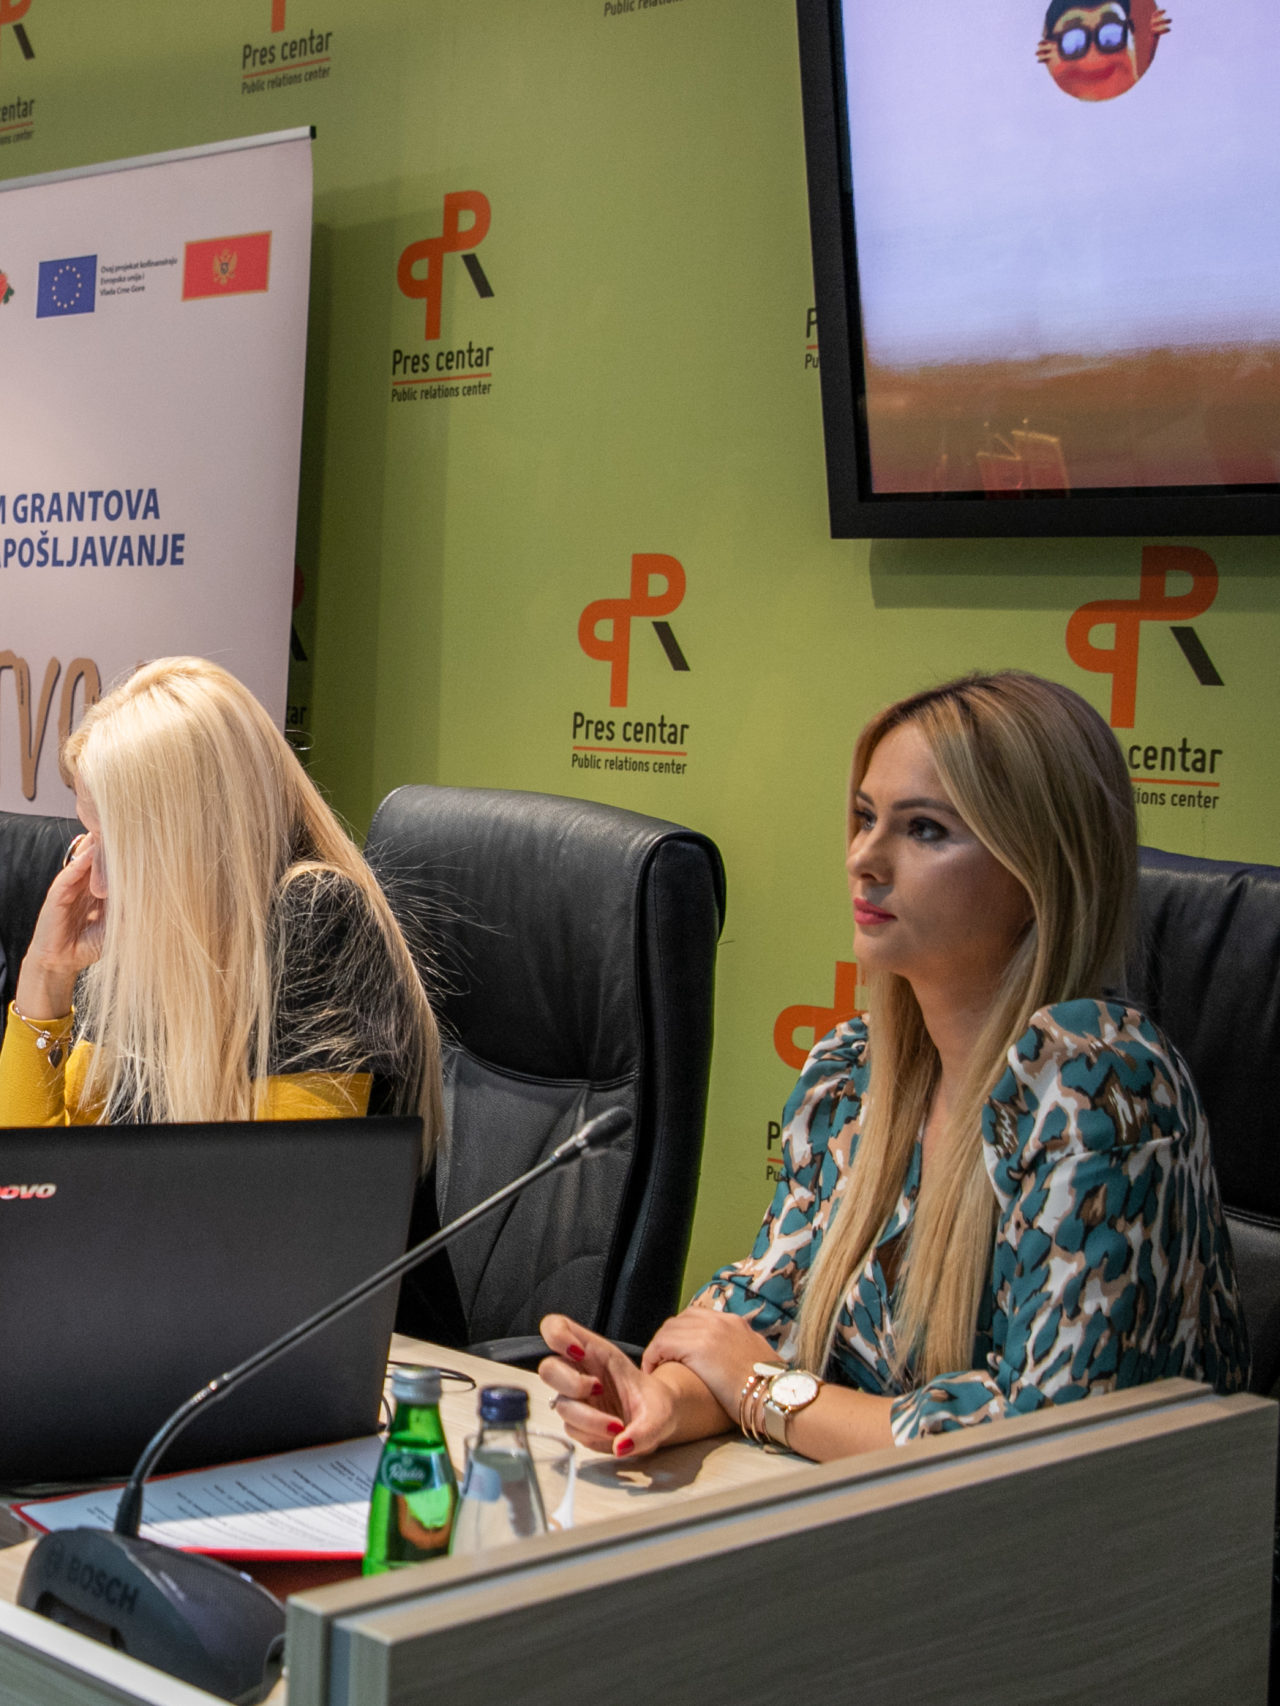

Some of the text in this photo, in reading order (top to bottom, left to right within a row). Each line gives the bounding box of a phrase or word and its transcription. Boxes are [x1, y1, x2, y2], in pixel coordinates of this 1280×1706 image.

[242, 28, 333, 70] Pres centar
[392, 340, 494, 376] Pres centar
[391, 380, 492, 403] Public relations center
[12, 488, 161, 524] GRANTOVA
[572, 711, 690, 745] Pres centar
[571, 753, 688, 775] Public relations center
[1128, 737, 1224, 774] centar
[1170, 789, 1220, 809] center
